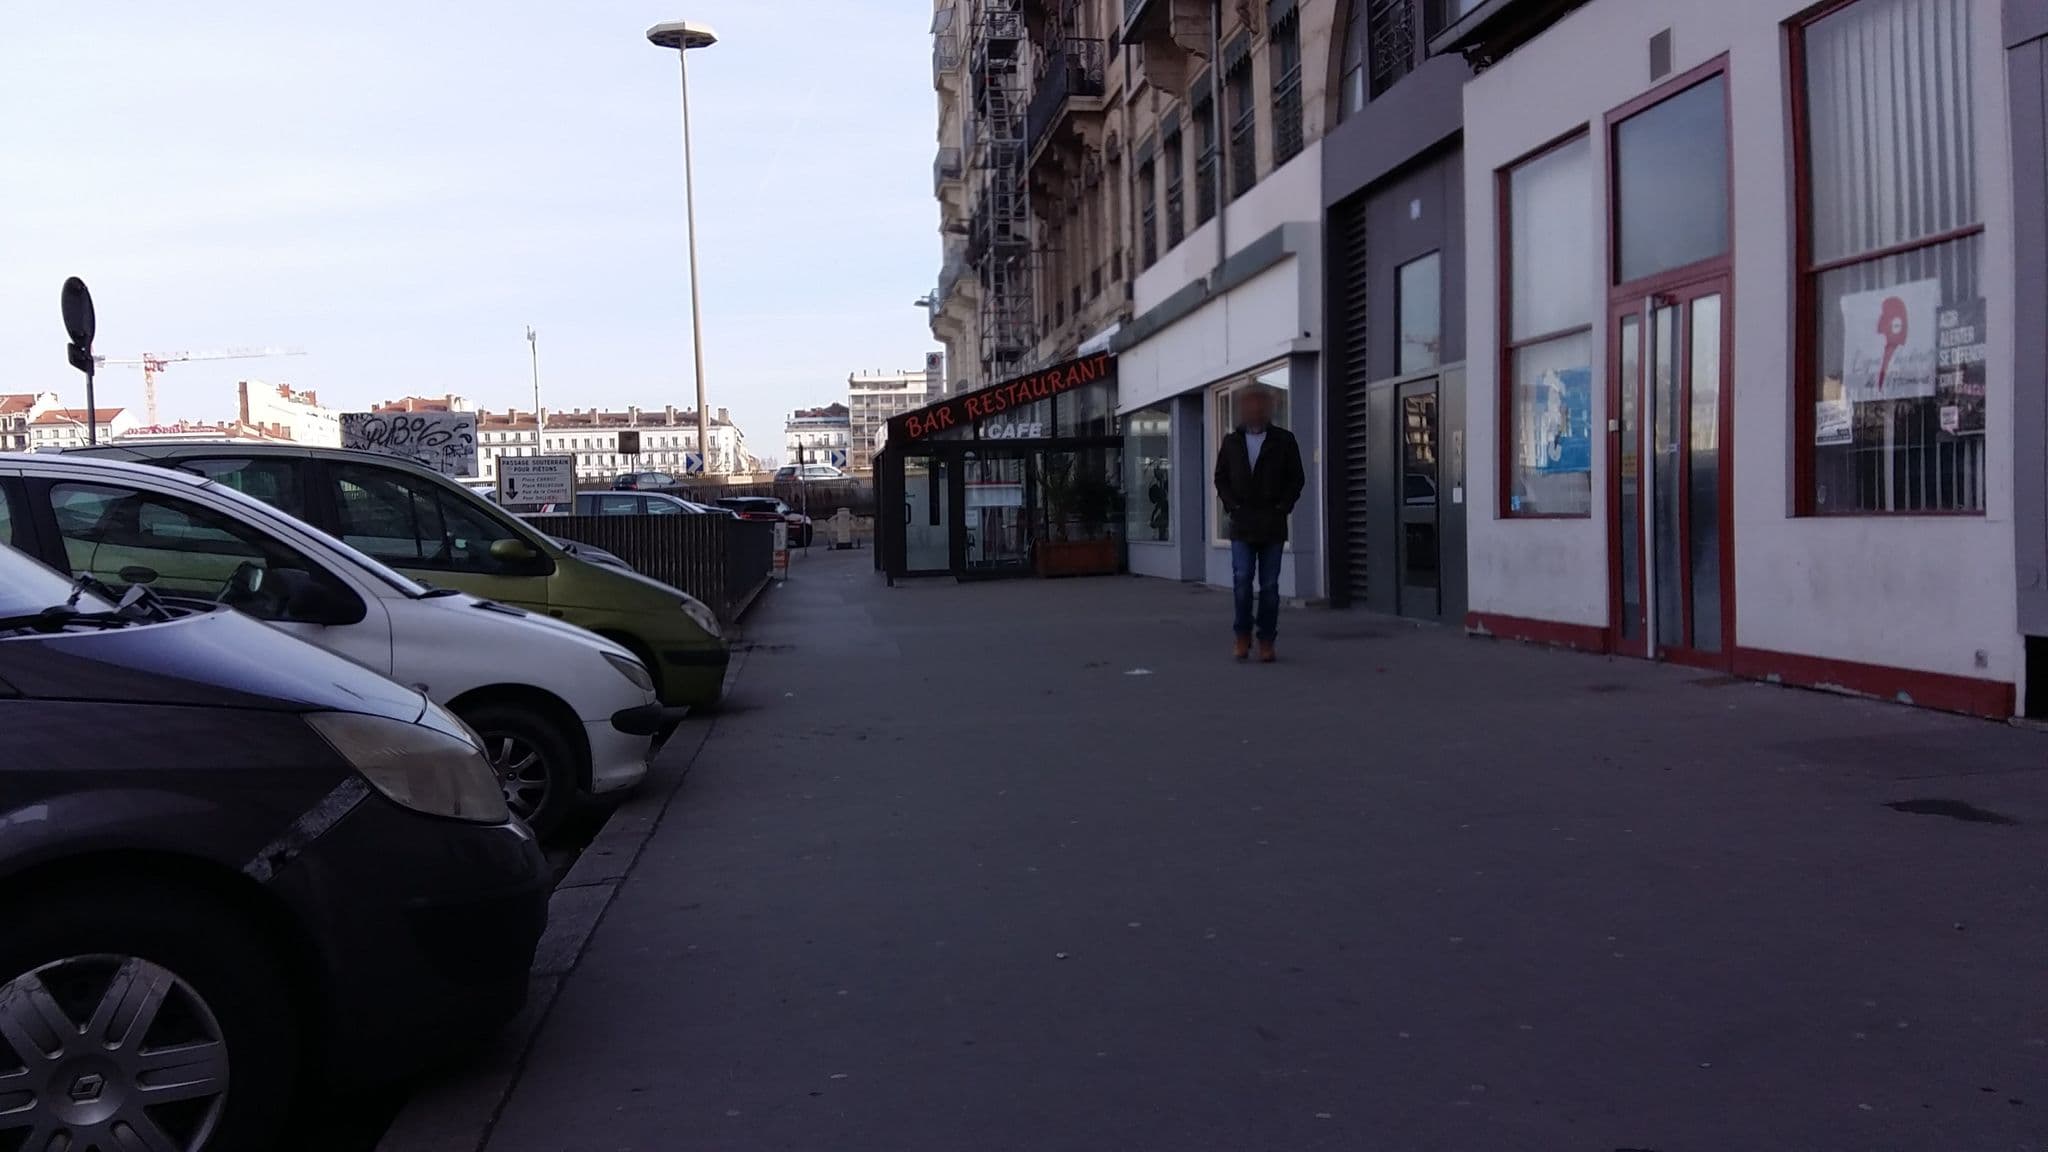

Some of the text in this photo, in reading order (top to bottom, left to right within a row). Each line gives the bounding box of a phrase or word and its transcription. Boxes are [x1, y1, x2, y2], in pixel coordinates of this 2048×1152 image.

[905, 406, 955, 438] BAR
[963, 355, 1109, 422] RESTAURANT
[987, 422, 1043, 438] CAFE
